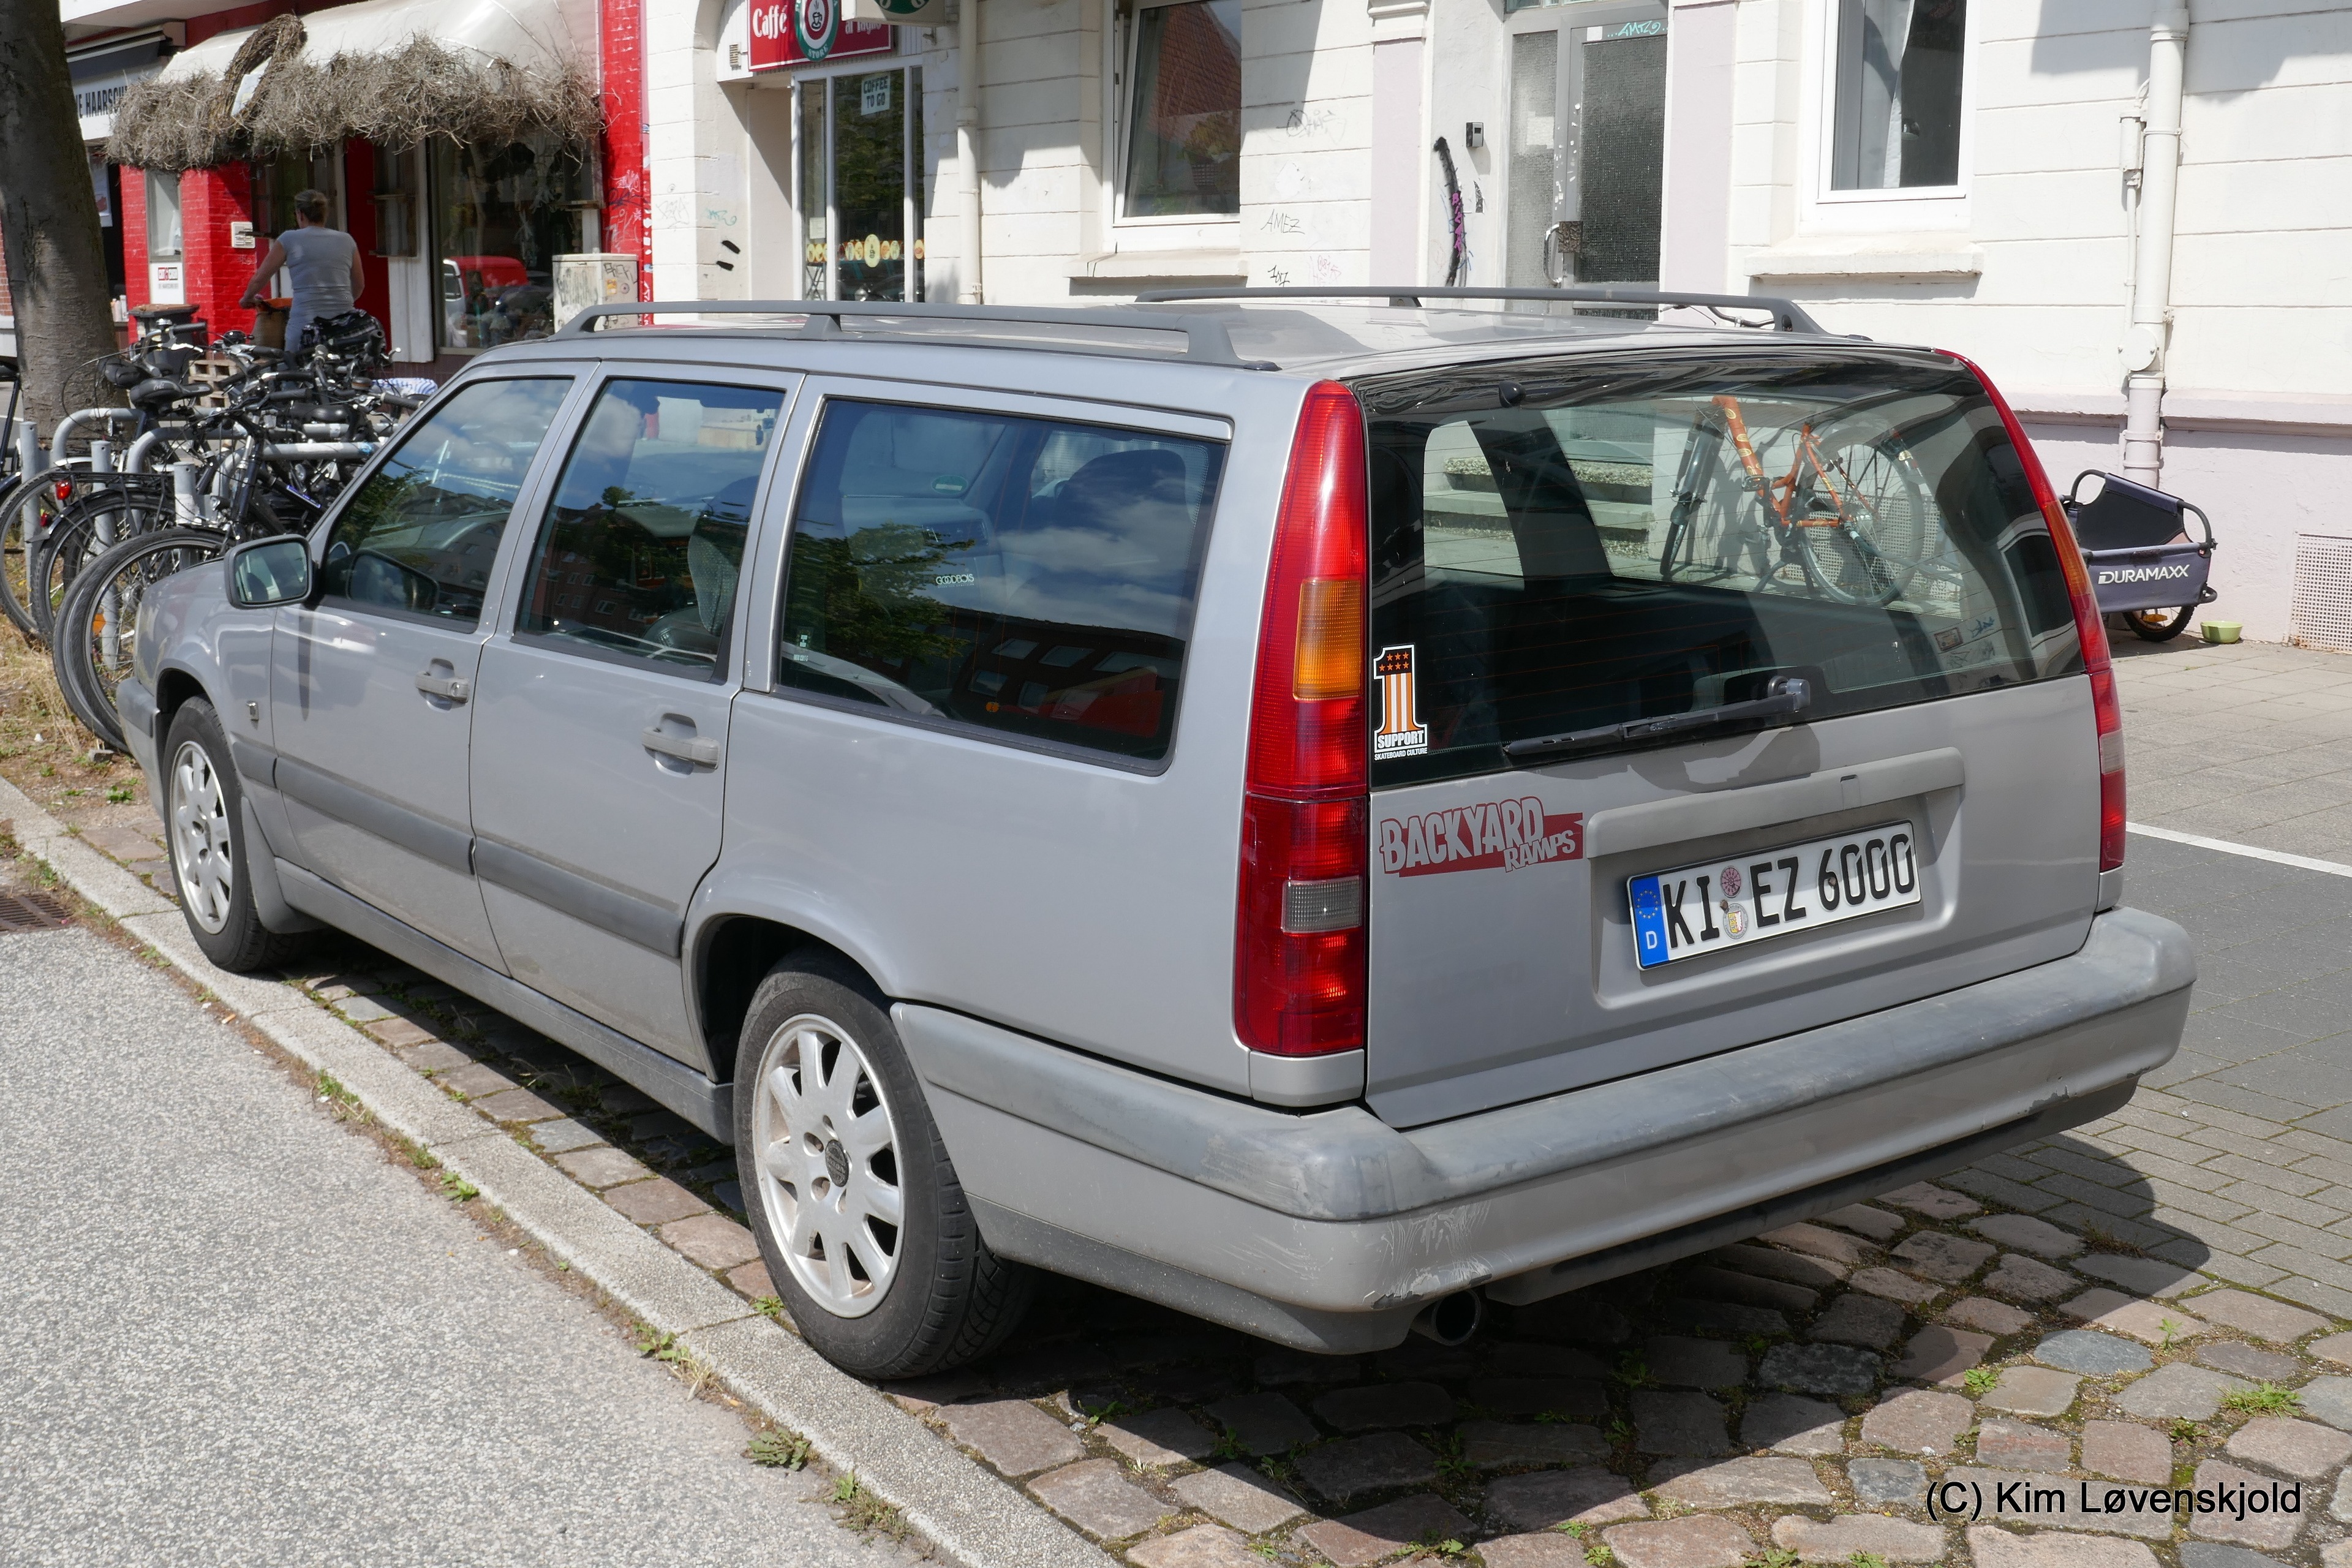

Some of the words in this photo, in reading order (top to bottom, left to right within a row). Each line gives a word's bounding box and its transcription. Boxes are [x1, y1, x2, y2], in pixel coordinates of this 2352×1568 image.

[752, 4, 788, 40] Caffé
[808, 43, 829, 59] STORE
[863, 75, 888, 94] COFFEE
[866, 96, 875, 108] TO
[876, 92, 886, 106] GO
[936, 573, 974, 585] GOODBOIS
[2098, 564, 2190, 584] DURAMAXX
[1378, 730, 1424, 748] SUPPORT
[1374, 750, 1406, 761] SKATEBOARD
[1407, 747, 1428, 756] CULTURE
[1379, 796, 1544, 874] BACKYARD
[1503, 829, 1576, 873] RAMPS
[1662, 875, 1720, 949] KI
[1749, 856, 1807, 929] EZ
[1818, 833, 1915, 911] 6000
[1646, 930, 1657, 949] D
